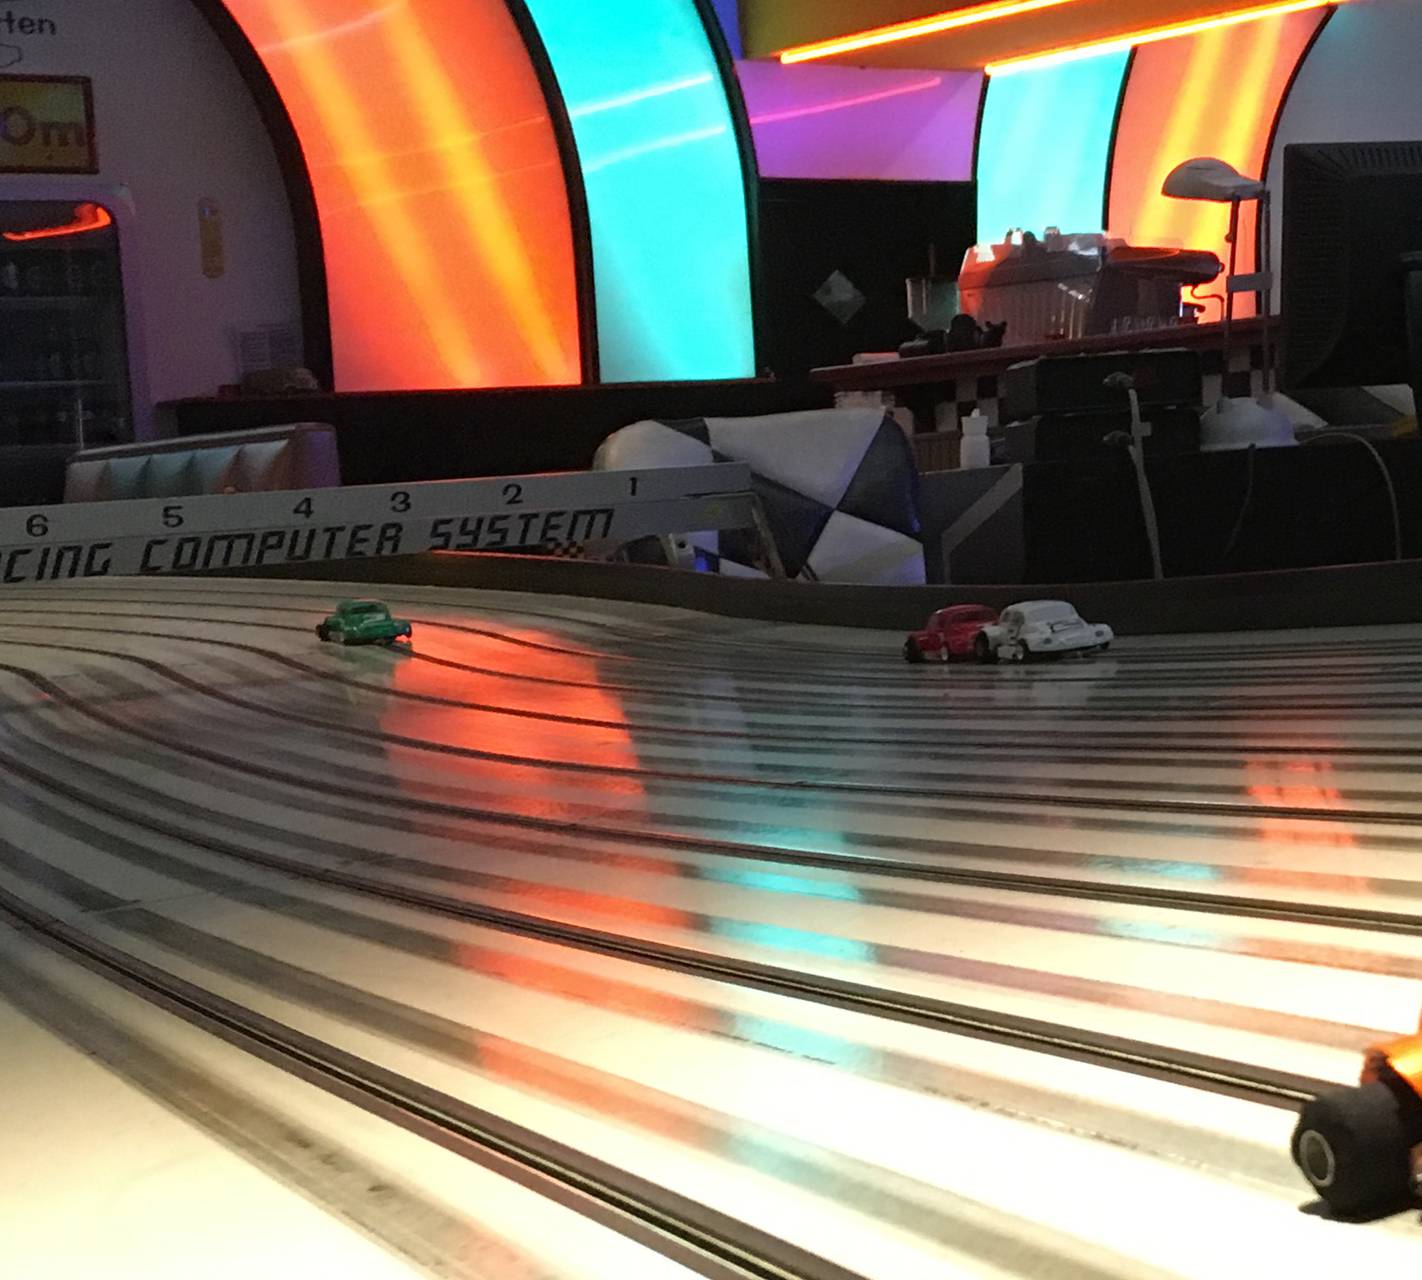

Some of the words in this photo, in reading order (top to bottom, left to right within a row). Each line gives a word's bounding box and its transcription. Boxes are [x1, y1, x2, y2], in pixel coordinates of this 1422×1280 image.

[0, 11, 57, 35] ten
[26, 514, 49, 537] 6
[162, 505, 184, 528] 5
[292, 497, 314, 519] 4
[390, 491, 412, 513] 3
[502, 483, 524, 505] 2
[629, 476, 638, 497] 1
[0, 542, 112, 584] CING
[140, 522, 403, 574] COMPUTER
[429, 508, 615, 551] SYSTEM
